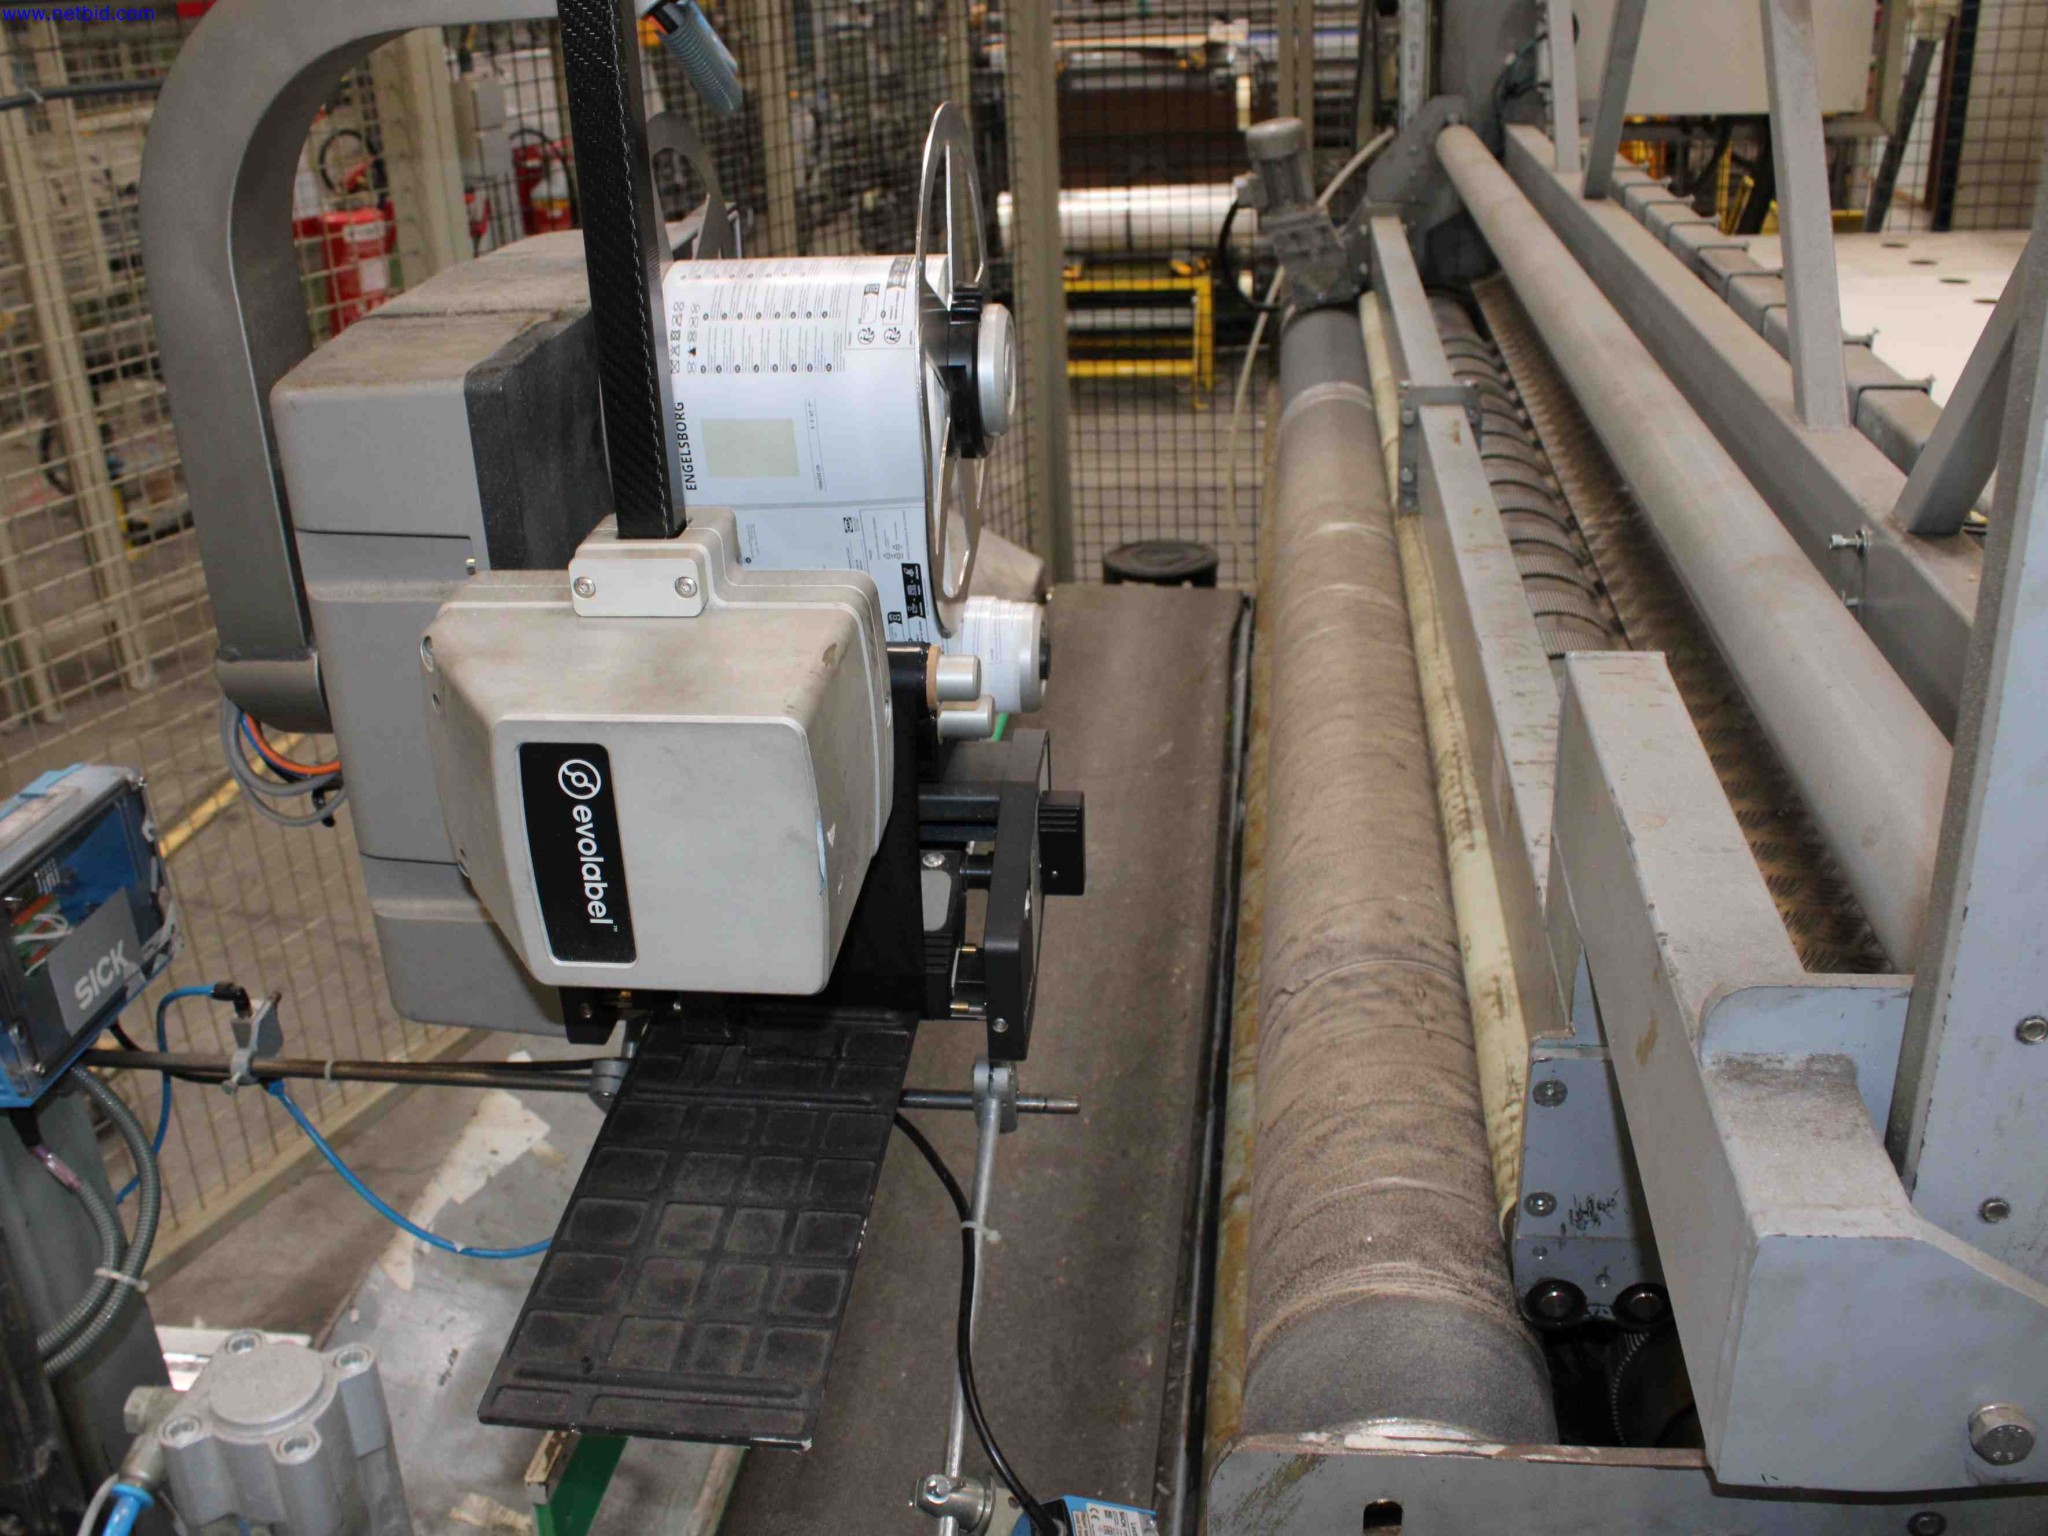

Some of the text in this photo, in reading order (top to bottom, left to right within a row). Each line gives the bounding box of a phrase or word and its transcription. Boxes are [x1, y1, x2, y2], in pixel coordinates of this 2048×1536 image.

[674, 402, 697, 491] ENGELSBORG
[572, 805, 613, 924] evolabel
[75, 940, 129, 1010] SICK
